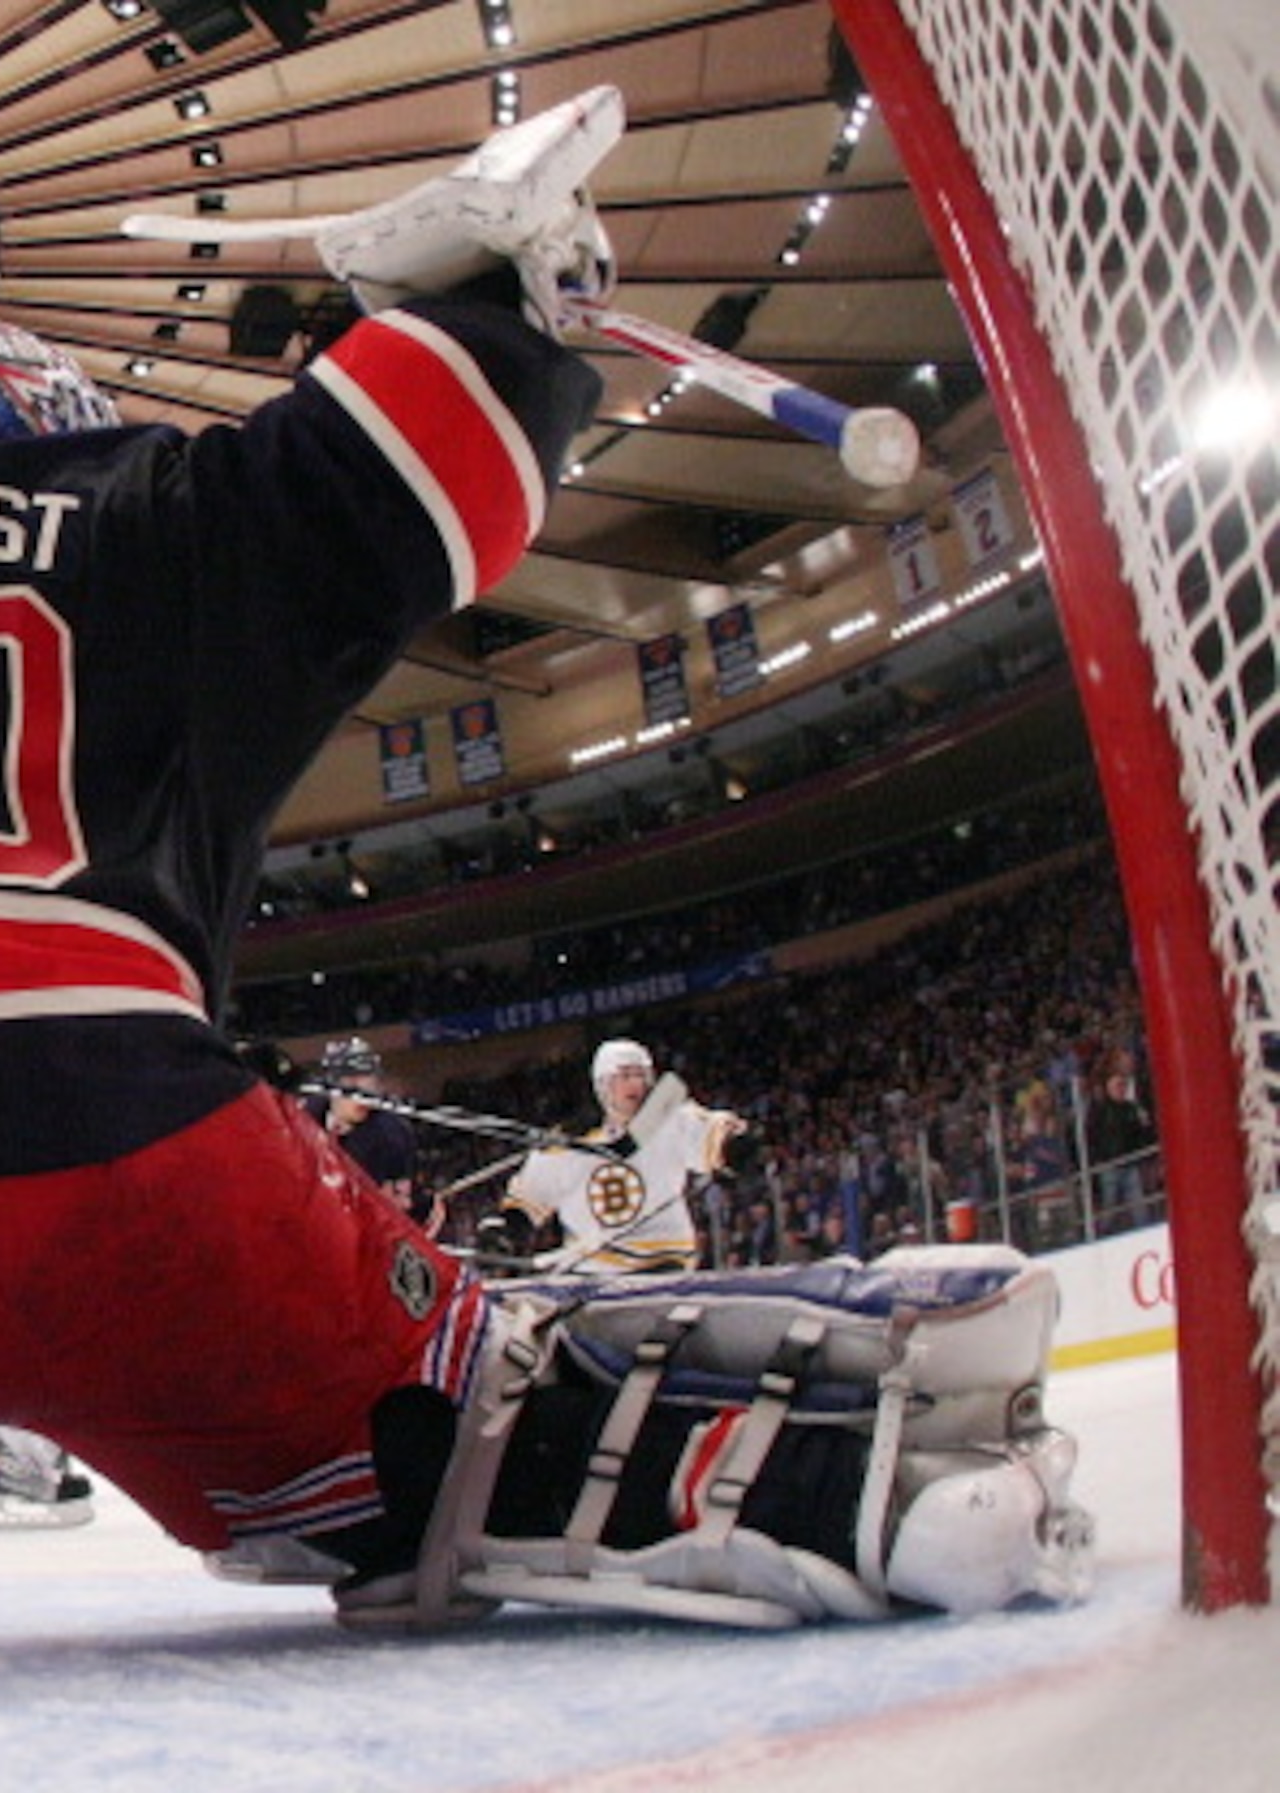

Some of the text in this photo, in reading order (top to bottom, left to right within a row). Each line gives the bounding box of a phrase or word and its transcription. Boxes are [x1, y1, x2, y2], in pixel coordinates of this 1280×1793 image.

[974, 508, 999, 553] 2
[907, 552, 923, 590] 1
[493, 971, 687, 1031] LET'S GO RANGERS
